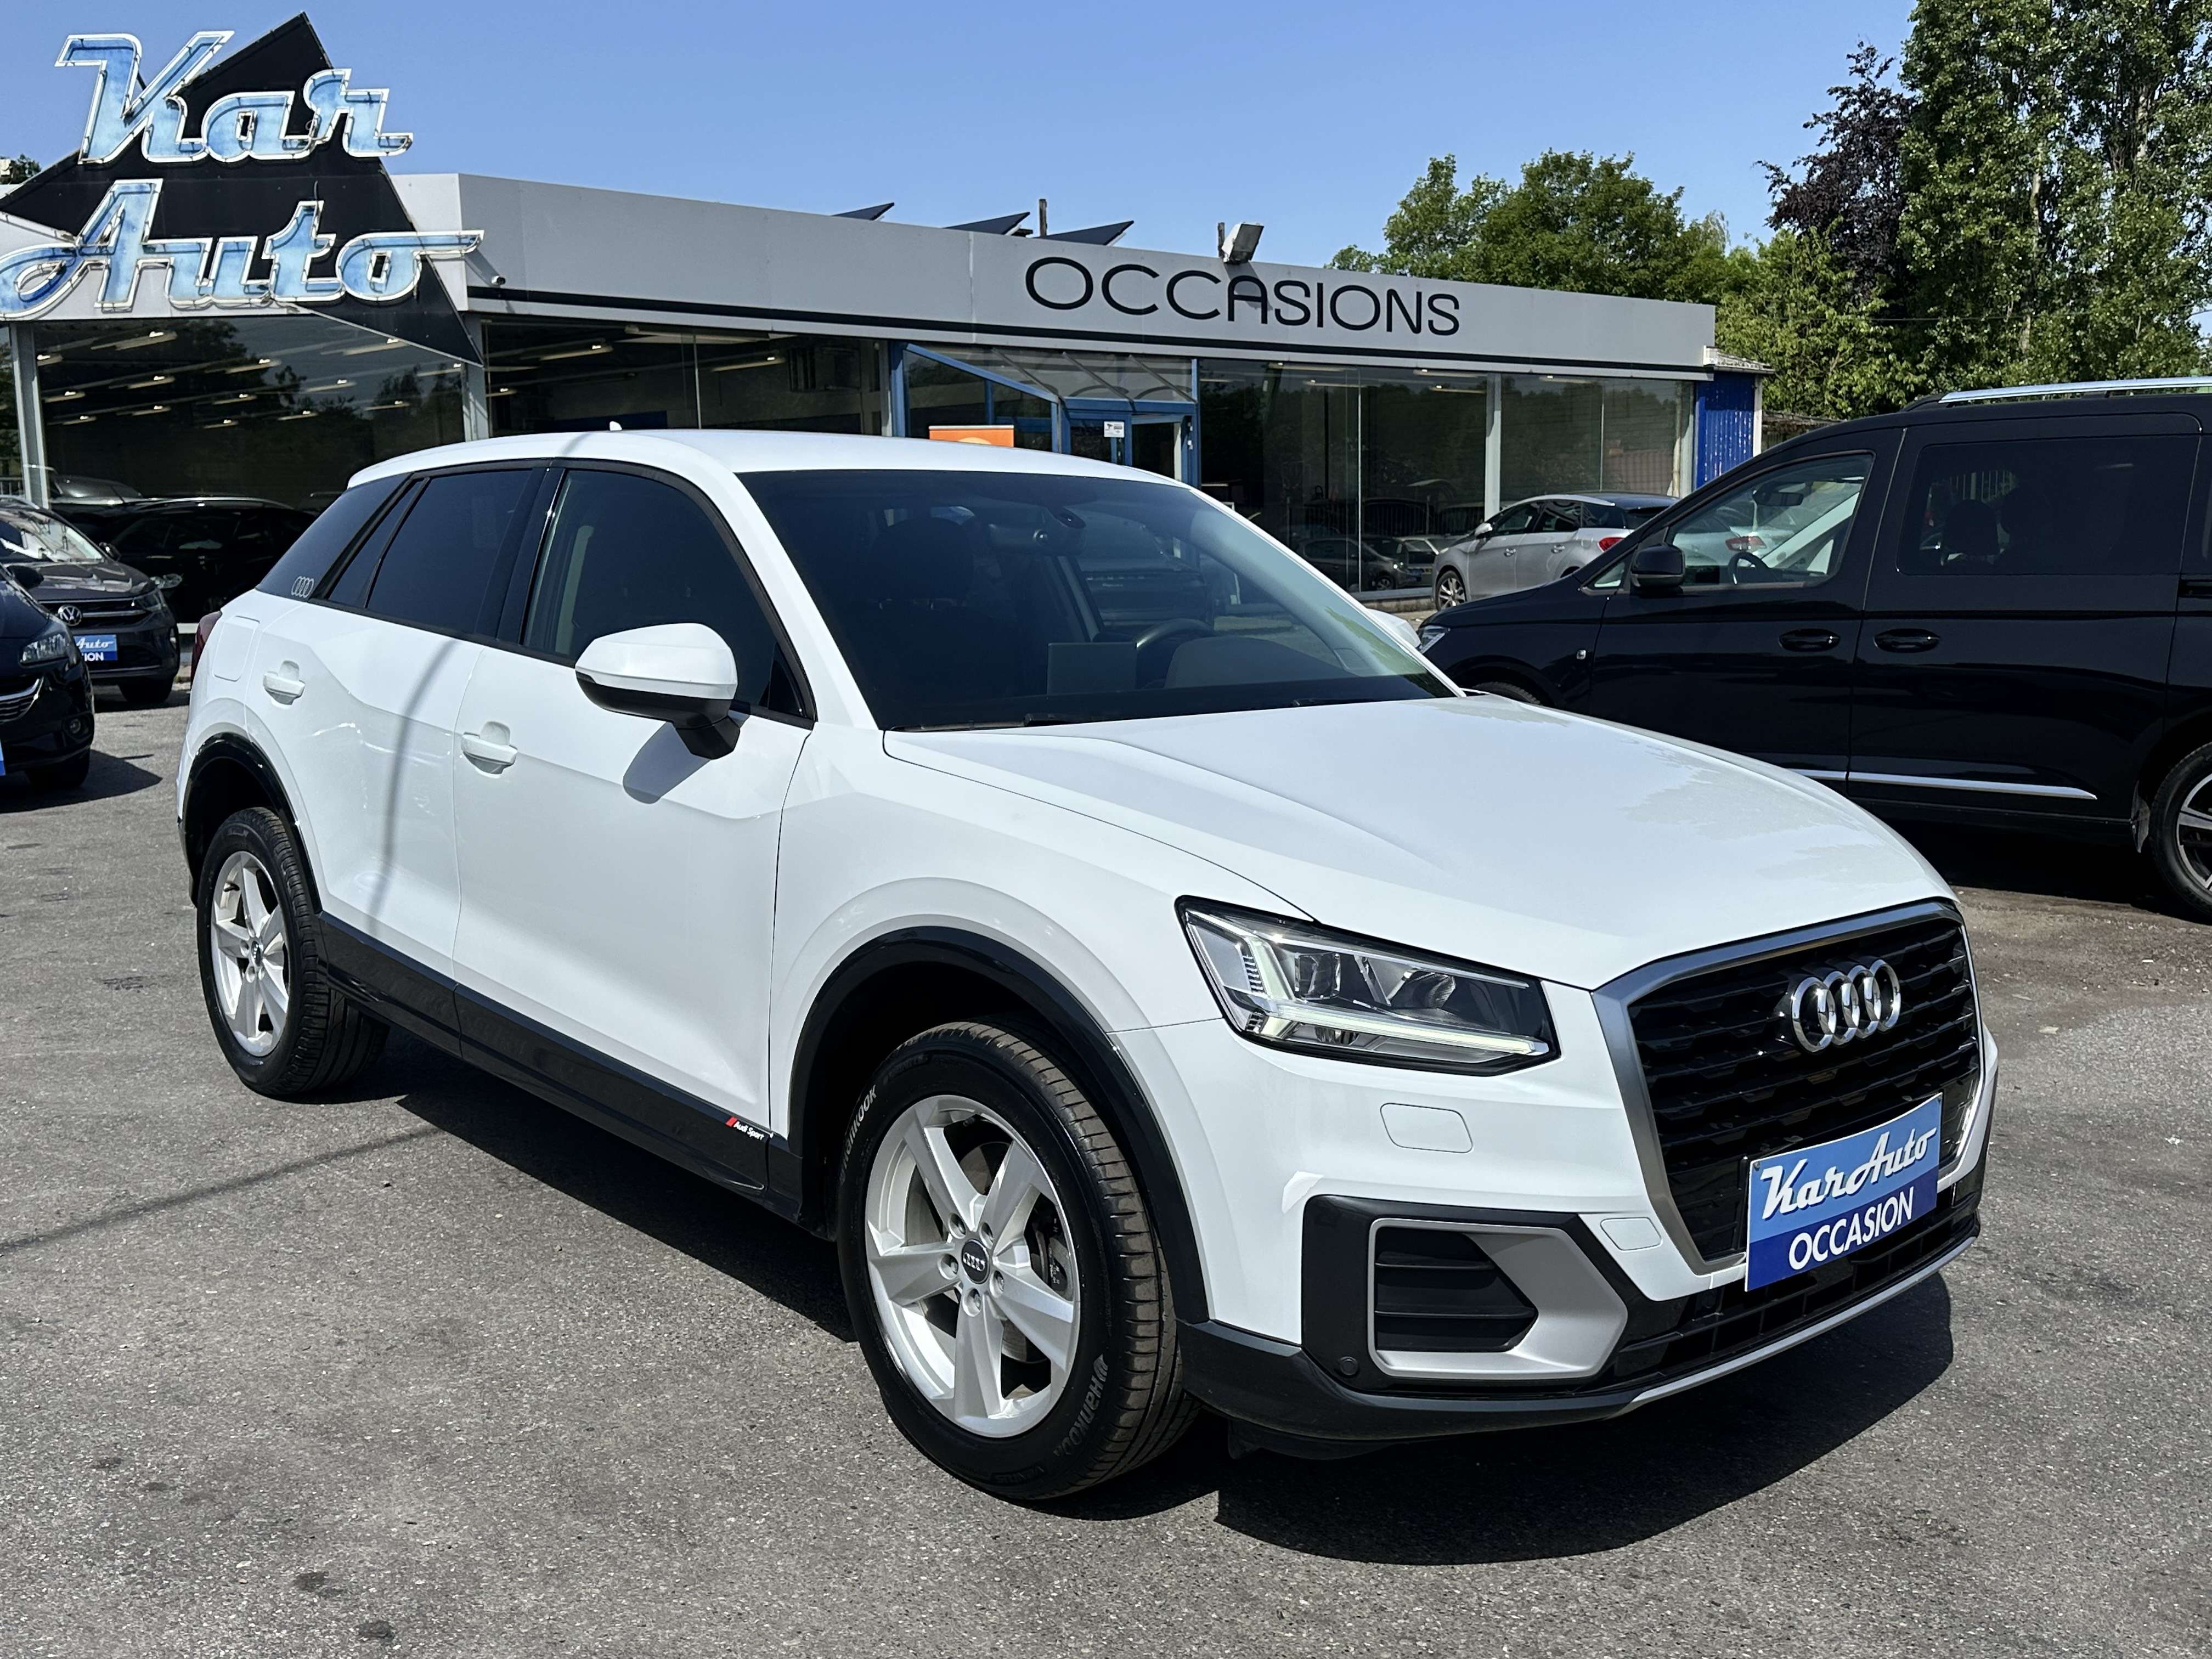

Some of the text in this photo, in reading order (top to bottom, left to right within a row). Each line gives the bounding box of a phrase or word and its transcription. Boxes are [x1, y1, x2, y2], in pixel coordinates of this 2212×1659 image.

[55, 30, 414, 165] Kar
[0, 178, 484, 321] Auto
[1025, 256, 1460, 336] OCCASIONS
[76, 637, 115, 650] Auto
[733, 1121, 765, 1141] Audi Sport
[1788, 1187, 1915, 1271] OCCASION
